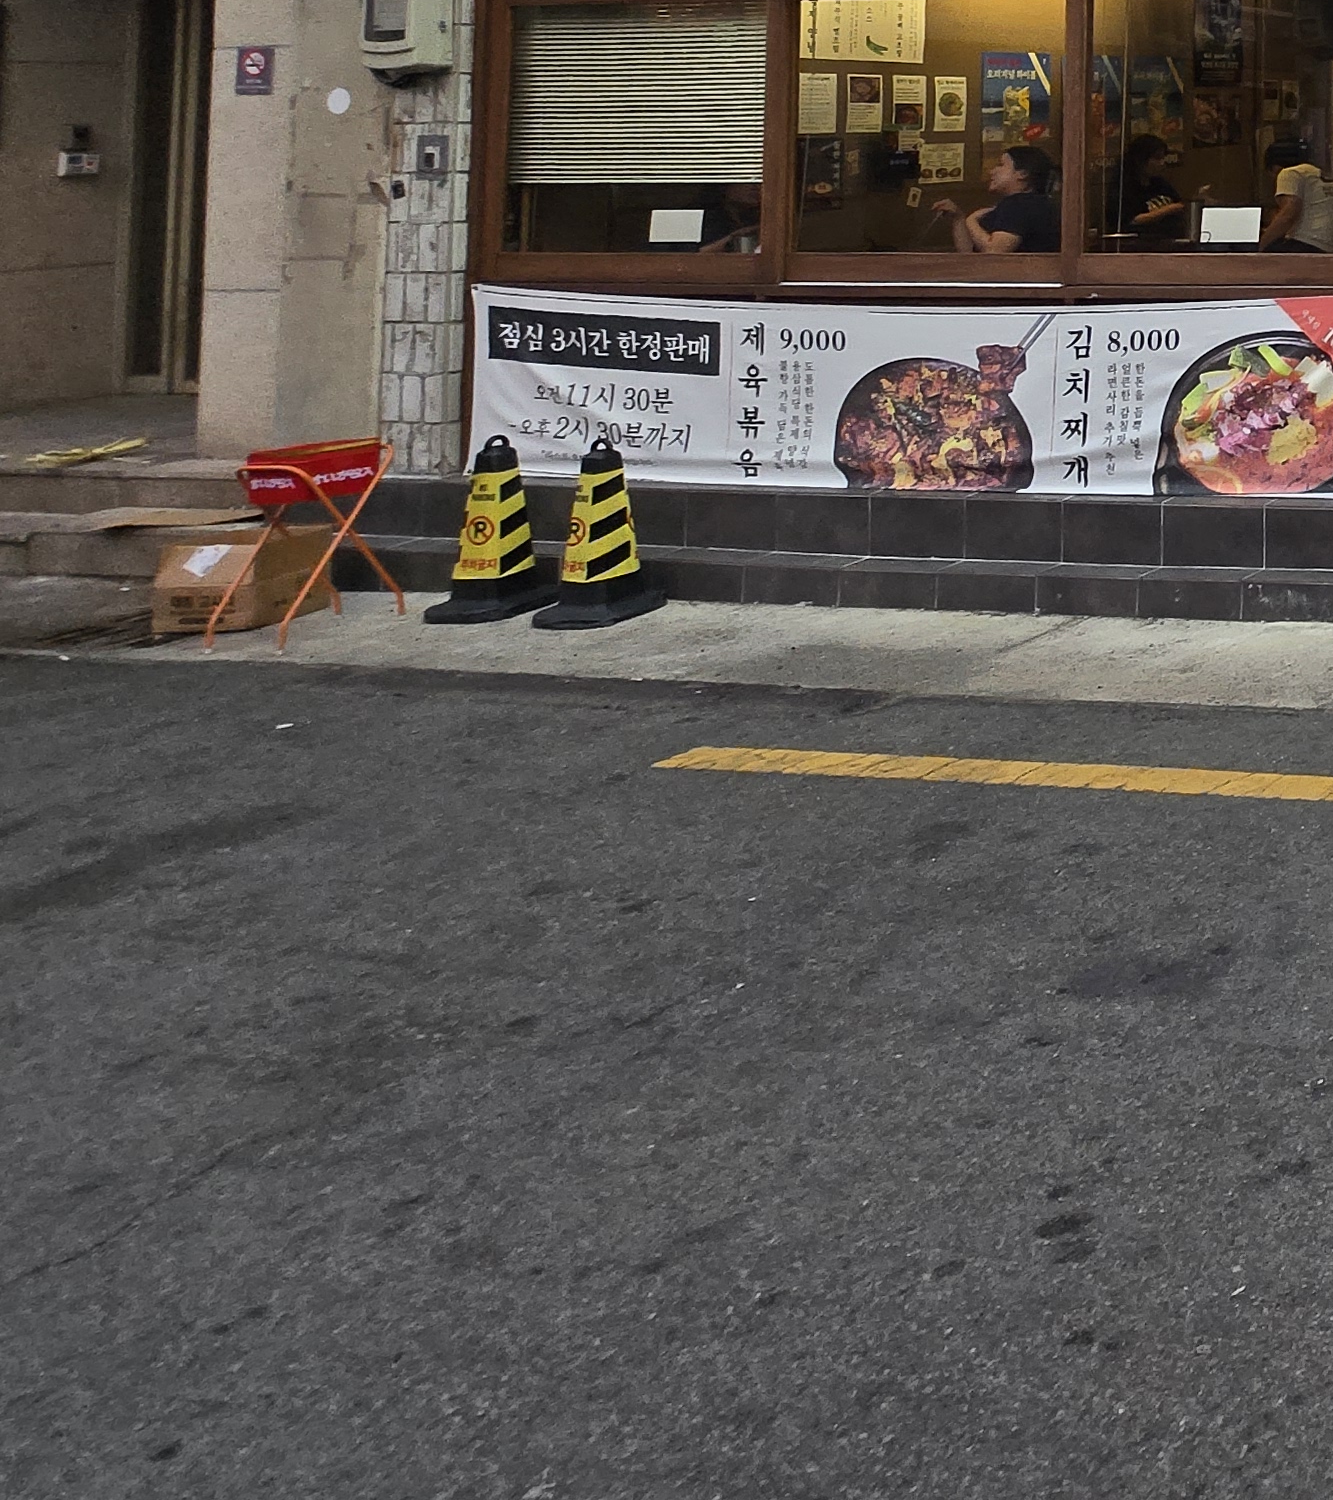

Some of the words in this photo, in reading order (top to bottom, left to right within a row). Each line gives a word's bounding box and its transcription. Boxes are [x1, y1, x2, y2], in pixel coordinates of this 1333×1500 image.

[498, 322, 544, 353] 점심
[550, 328, 612, 358] 3시간
[616, 331, 710, 365] 한정판매
[779, 328, 847, 354] 9,000
[1107, 328, 1181, 357] 8,000
[623, 387, 674, 414] 30분
[732, 322, 768, 477] 제육볶음
[1059, 325, 1092, 488] 김치찌개
[1106, 362, 1118, 416] 라면사리
